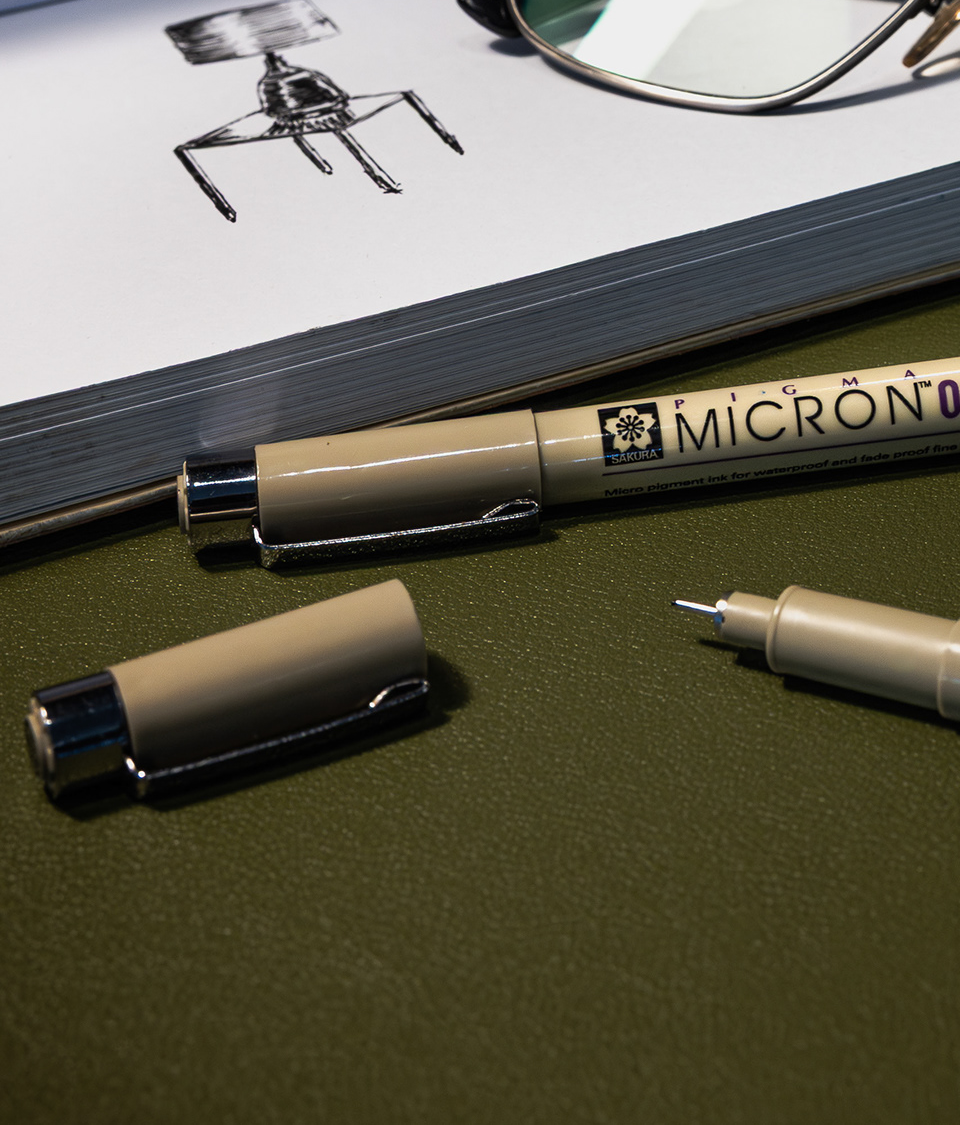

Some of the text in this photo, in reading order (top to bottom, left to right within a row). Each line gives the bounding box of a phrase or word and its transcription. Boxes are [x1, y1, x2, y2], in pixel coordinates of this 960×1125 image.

[674, 369, 915, 409] PIGMA
[675, 382, 923, 453] MICRON
[604, 485, 644, 497] Micro
[647, 478, 704, 493] pigment
[708, 473, 727, 484] ink
[731, 471, 752, 481] for
[753, 460, 829, 476] waterproof
[832, 456, 857, 467] and
[861, 452, 890, 463] fade
[893, 446, 930, 459] proof
[933, 443, 957, 453] fine
[611, 449, 659, 465] SAKURA
